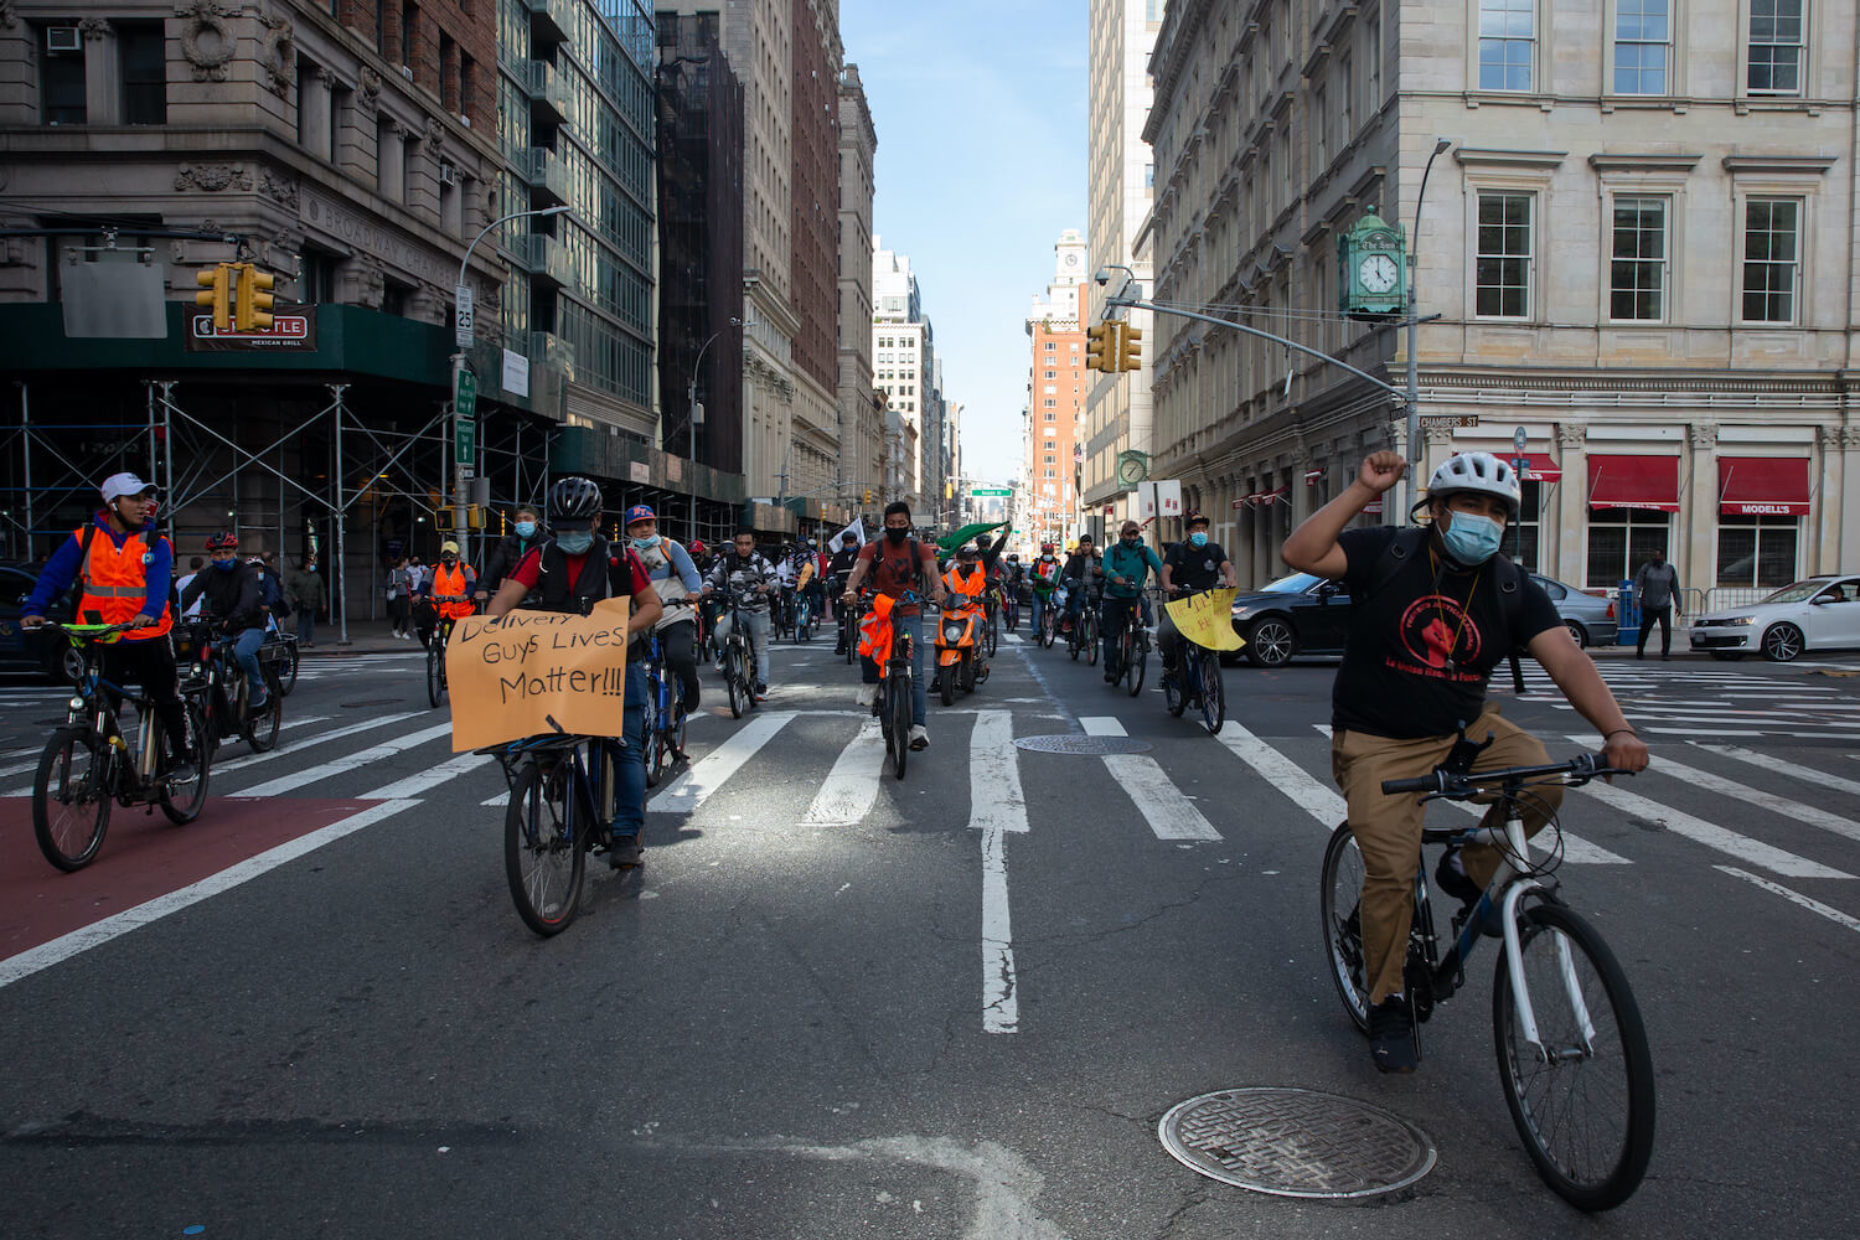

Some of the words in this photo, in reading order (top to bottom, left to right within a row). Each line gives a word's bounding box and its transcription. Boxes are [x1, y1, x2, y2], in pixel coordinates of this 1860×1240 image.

[325, 206, 401, 259] BROADWAY
[458, 311, 472, 328] 25
[1420, 416, 1462, 428] CHAMBERS
[1467, 416, 1478, 427] ST
[1741, 504, 1790, 515] MODELL'S
[461, 614, 574, 643] Delivery
[500, 666, 622, 705] Matter!!!
